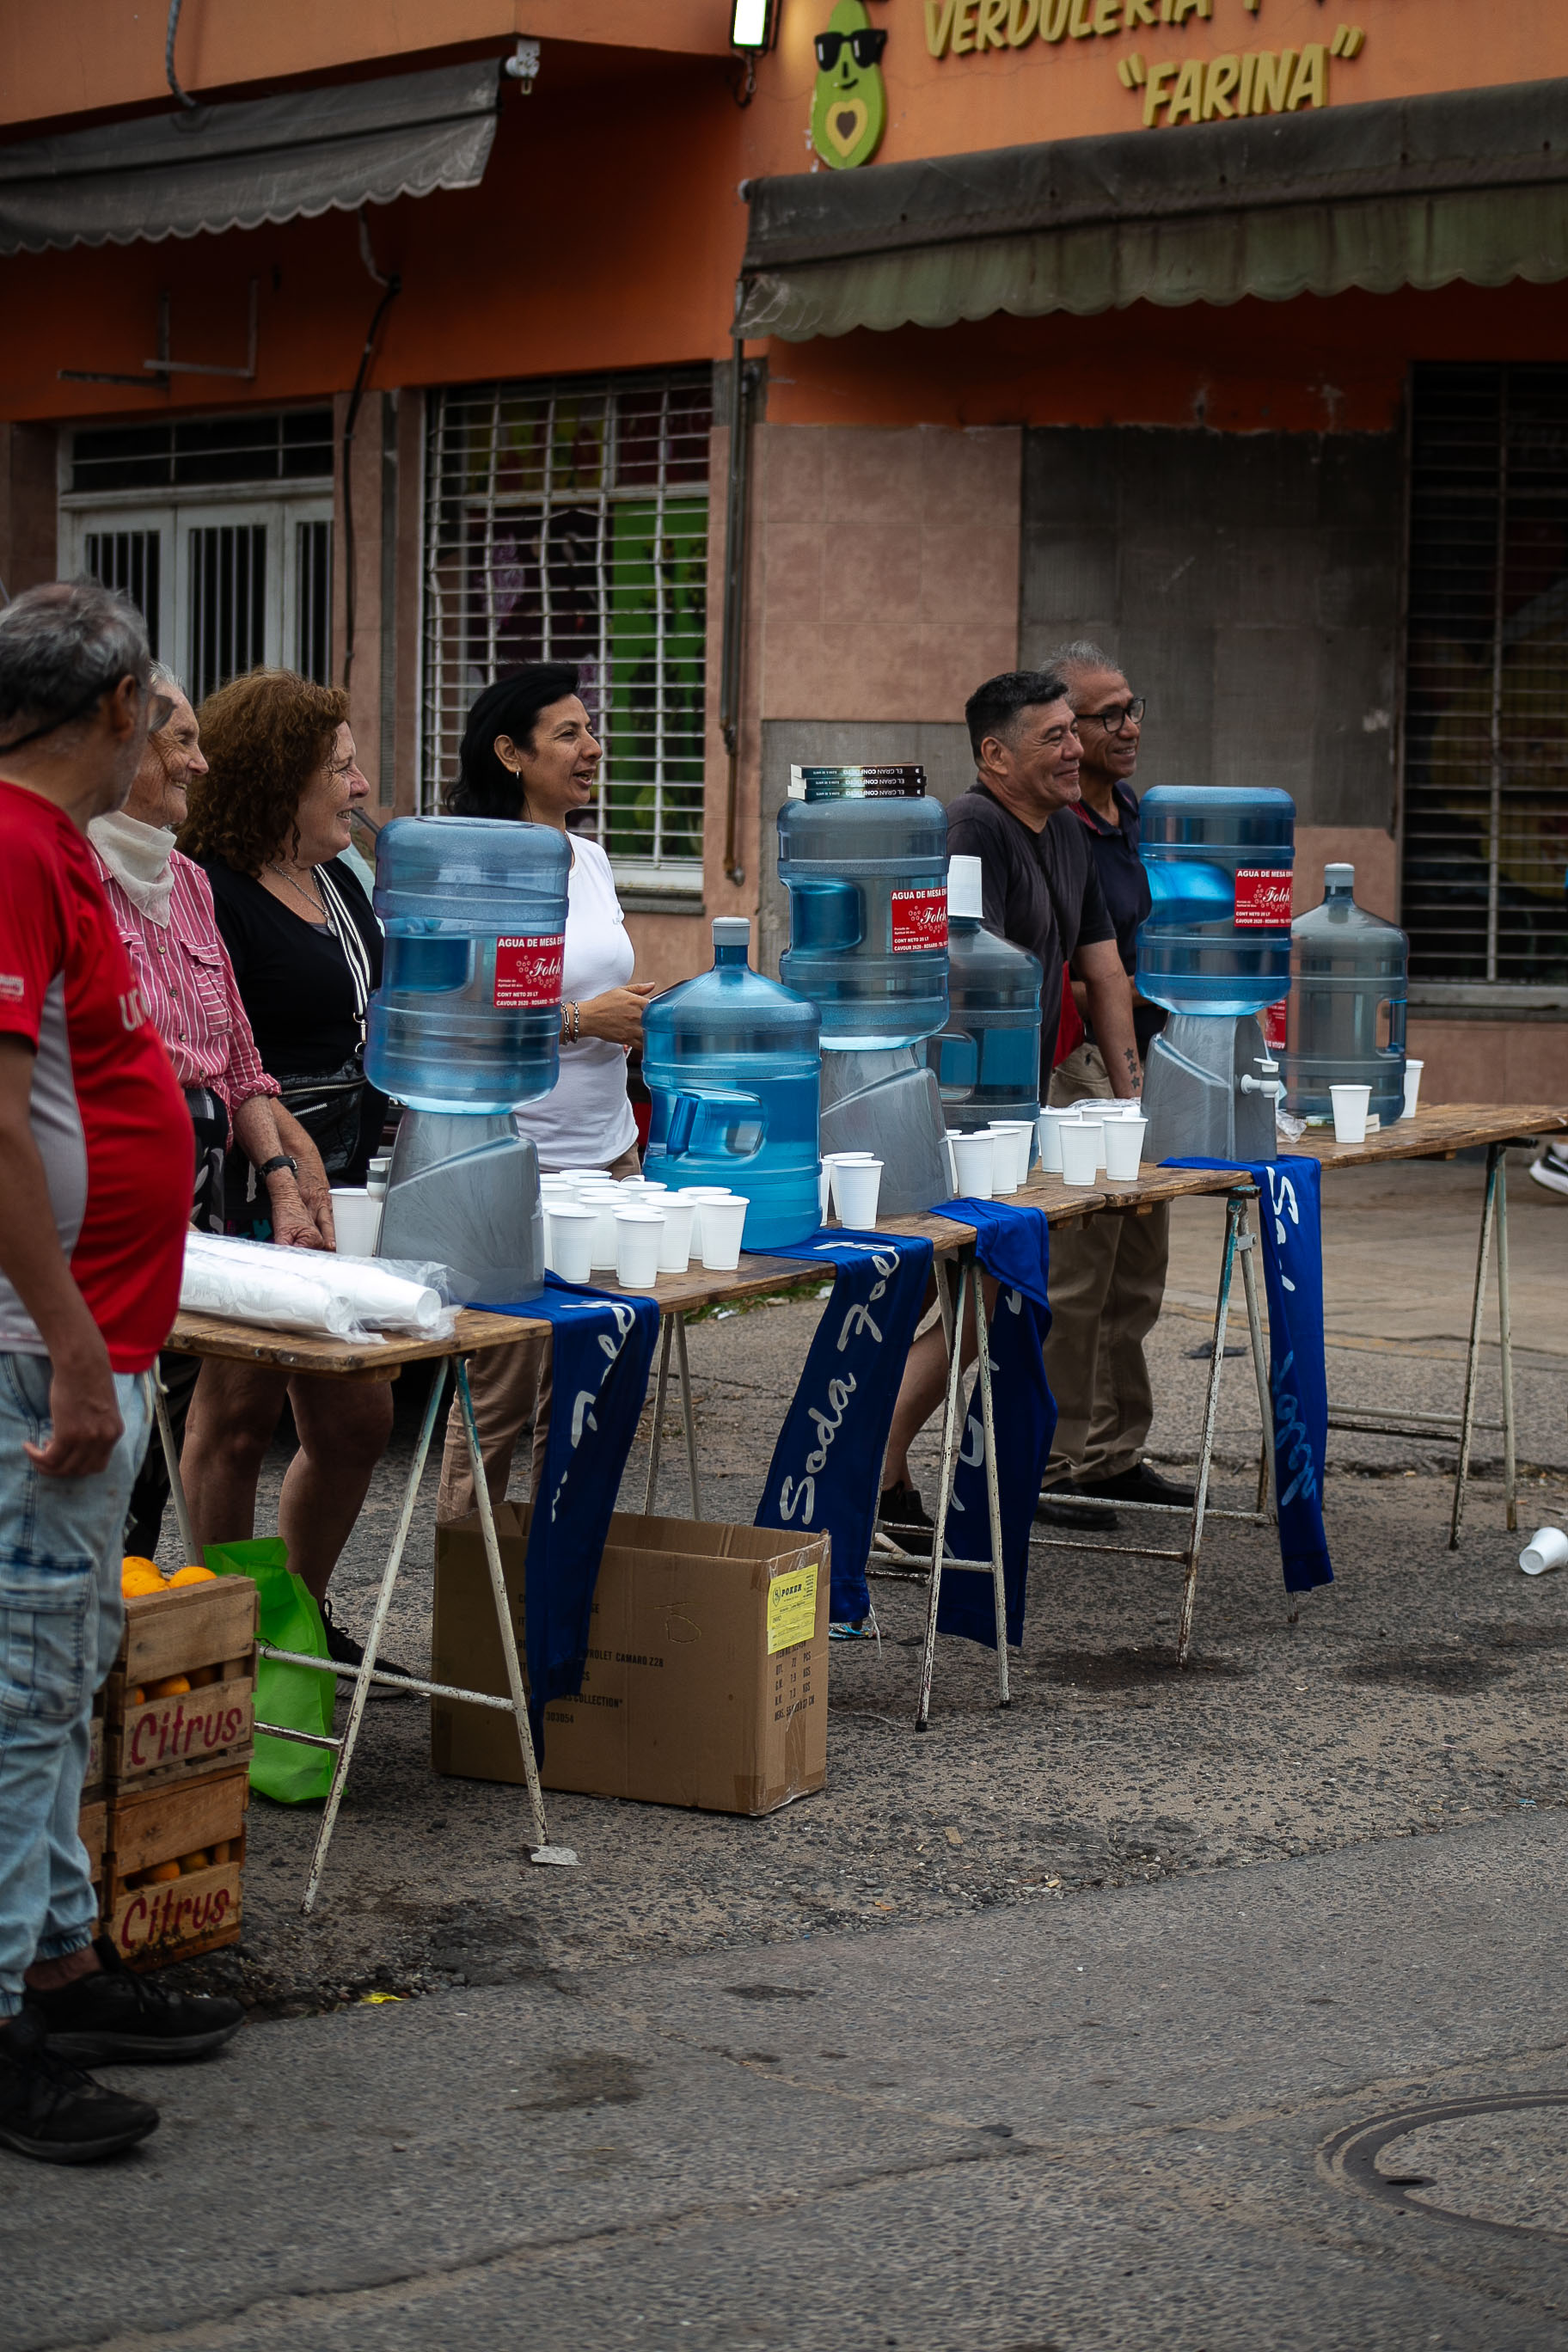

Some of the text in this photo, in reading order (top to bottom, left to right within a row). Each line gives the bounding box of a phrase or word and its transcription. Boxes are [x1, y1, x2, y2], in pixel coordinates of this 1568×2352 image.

[892, 891, 915, 900] AGUA
[916, 891, 926, 899] DE
[927, 889, 941, 897] MESA
[1263, 886, 1290, 903] Folch
[920, 906, 946, 924] Folch
[498, 938, 525, 947] AGUA
[527, 938, 538, 947] DE
[539, 937, 557, 947] MESA
[529, 957, 561, 977] Folch
[780, 1373, 857, 1525] Soda
[781, 1583, 803, 1597] POKER
[616, 1653, 647, 1666] CAMARO
[649, 1657, 664, 1668] Z28
[131, 1705, 242, 1766] Citrus
[121, 1889, 230, 1950] Citrus
